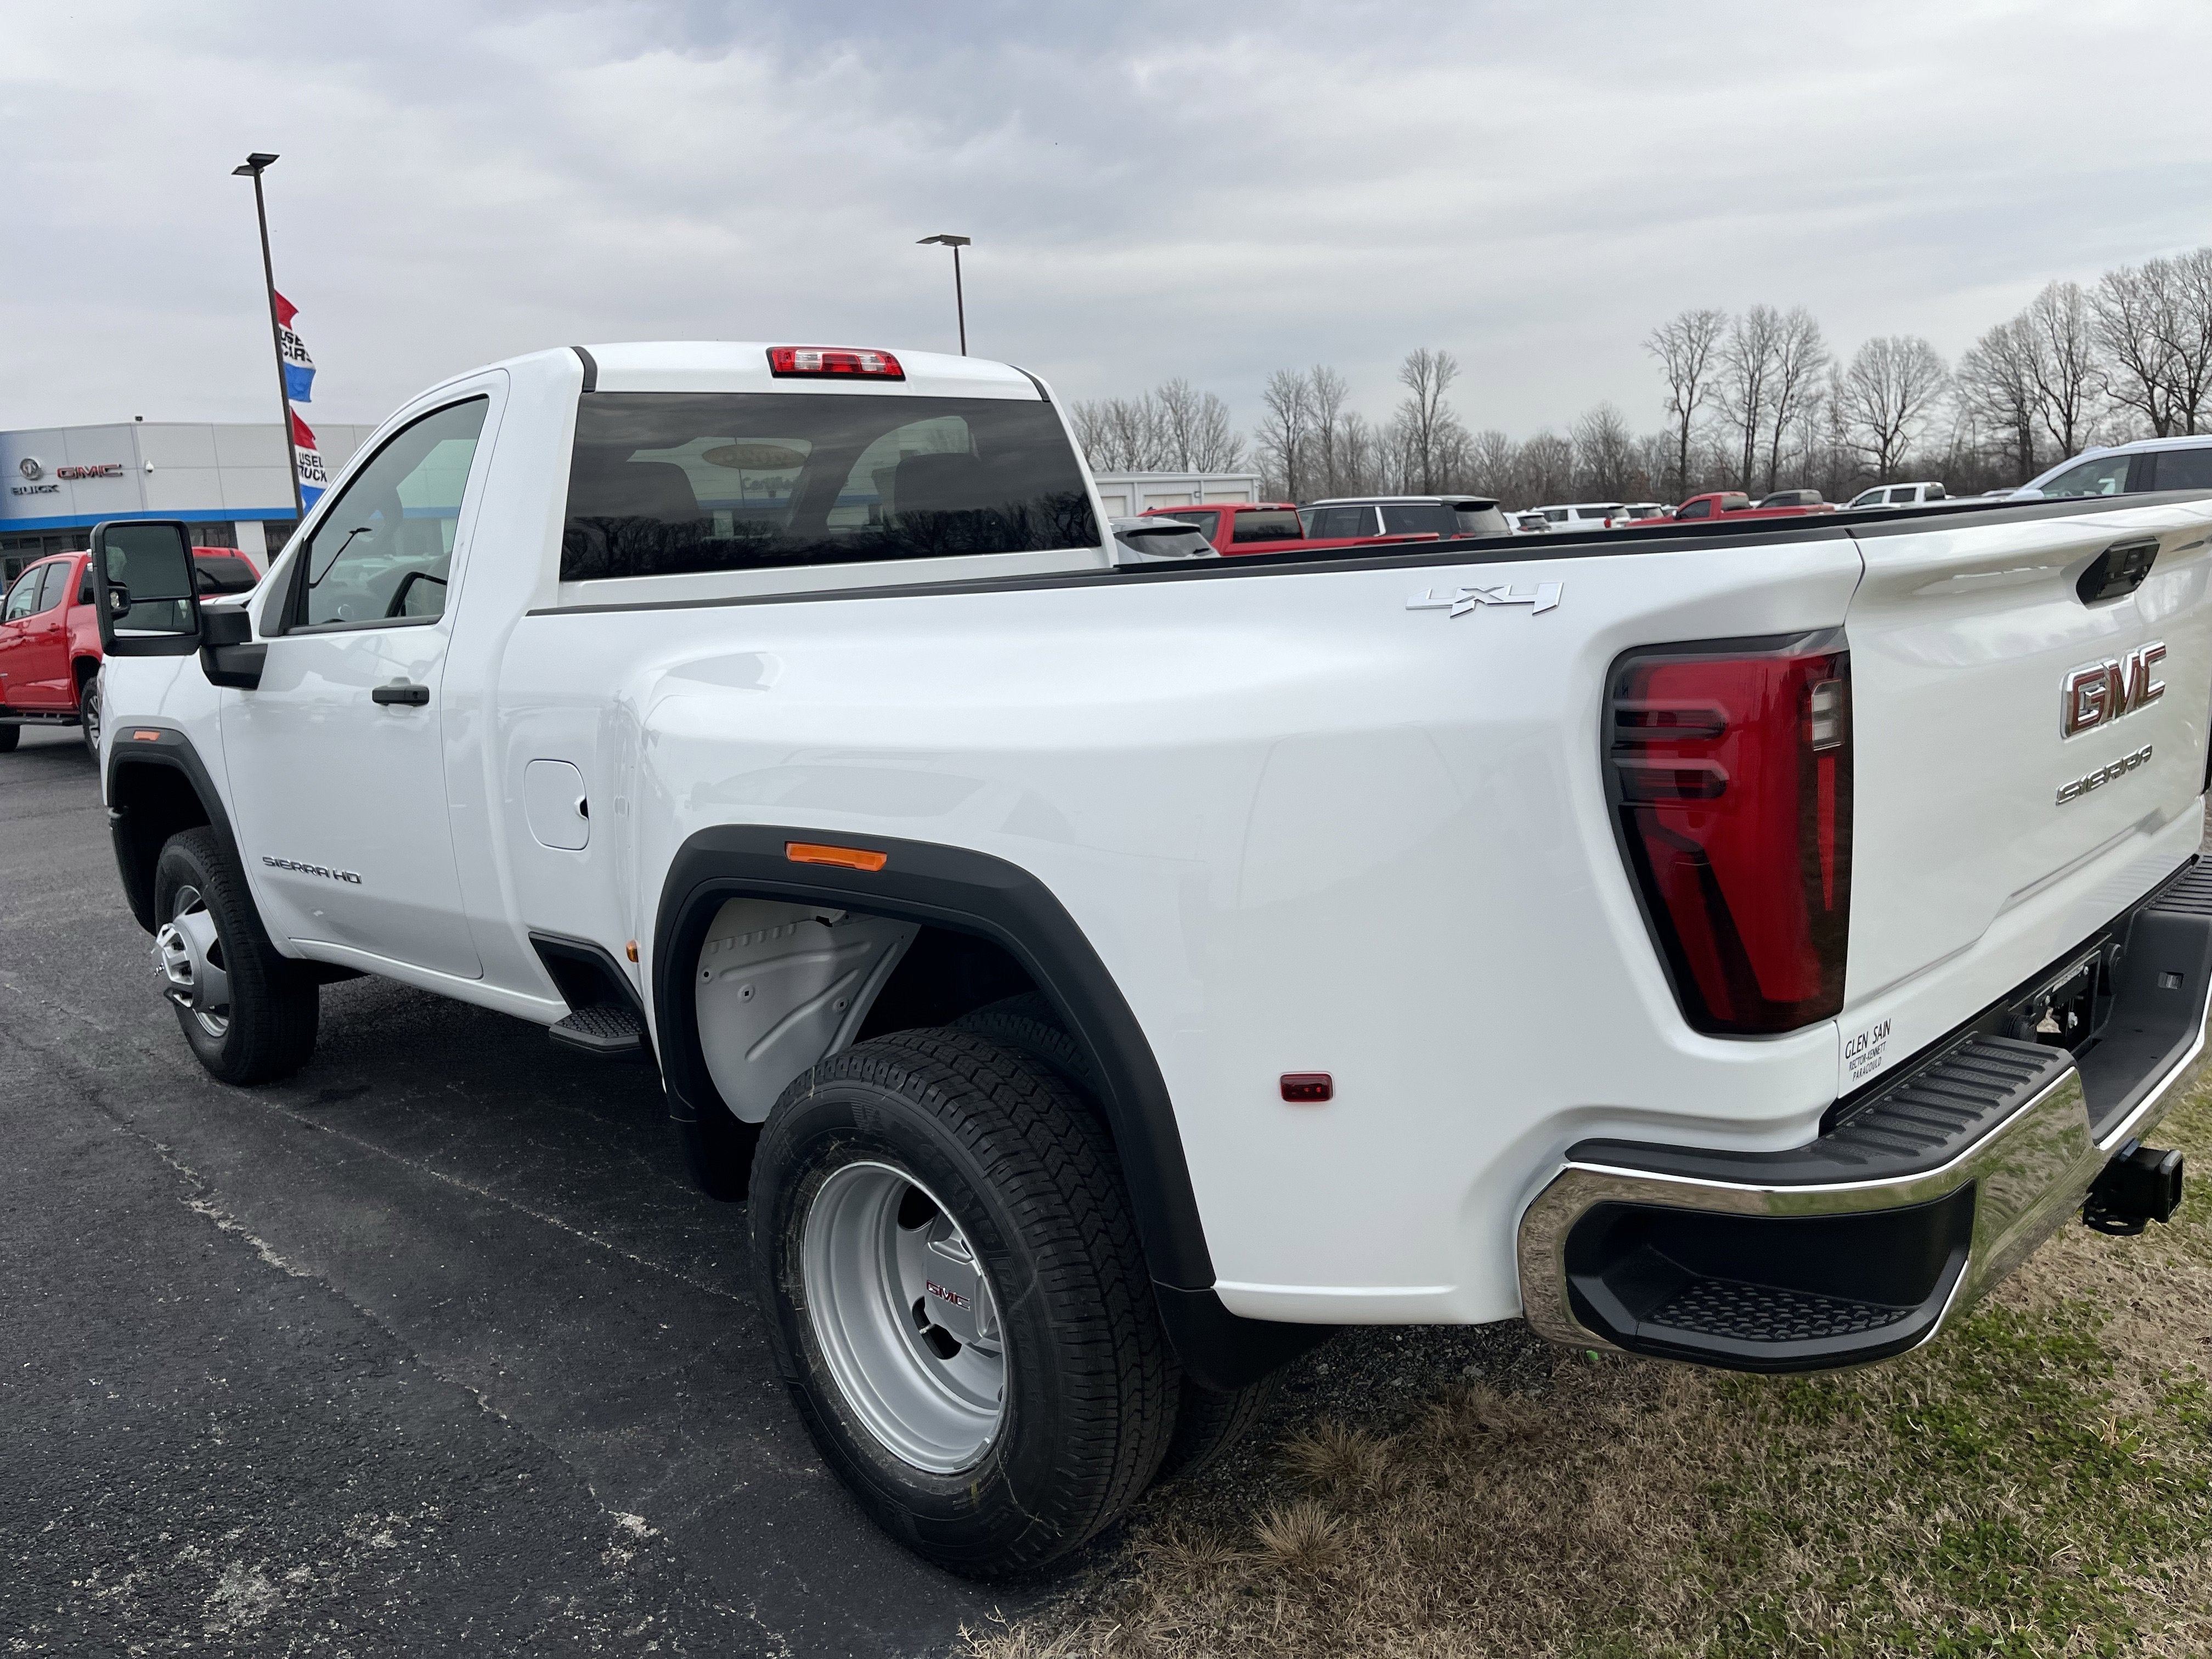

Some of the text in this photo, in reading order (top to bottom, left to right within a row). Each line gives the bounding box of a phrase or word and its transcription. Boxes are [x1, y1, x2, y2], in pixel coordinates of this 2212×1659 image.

[280, 330, 304, 347] USE
[57, 463, 123, 480] GMC
[10, 484, 60, 496] BUICK
[2060, 641, 2166, 740] GMC
[2056, 744, 2153, 806] SIERRA
[262, 855, 362, 884] SIERRA HD
[1845, 1018, 1891, 1059] GLEN SAIN
[926, 1279, 970, 1311] GMC
